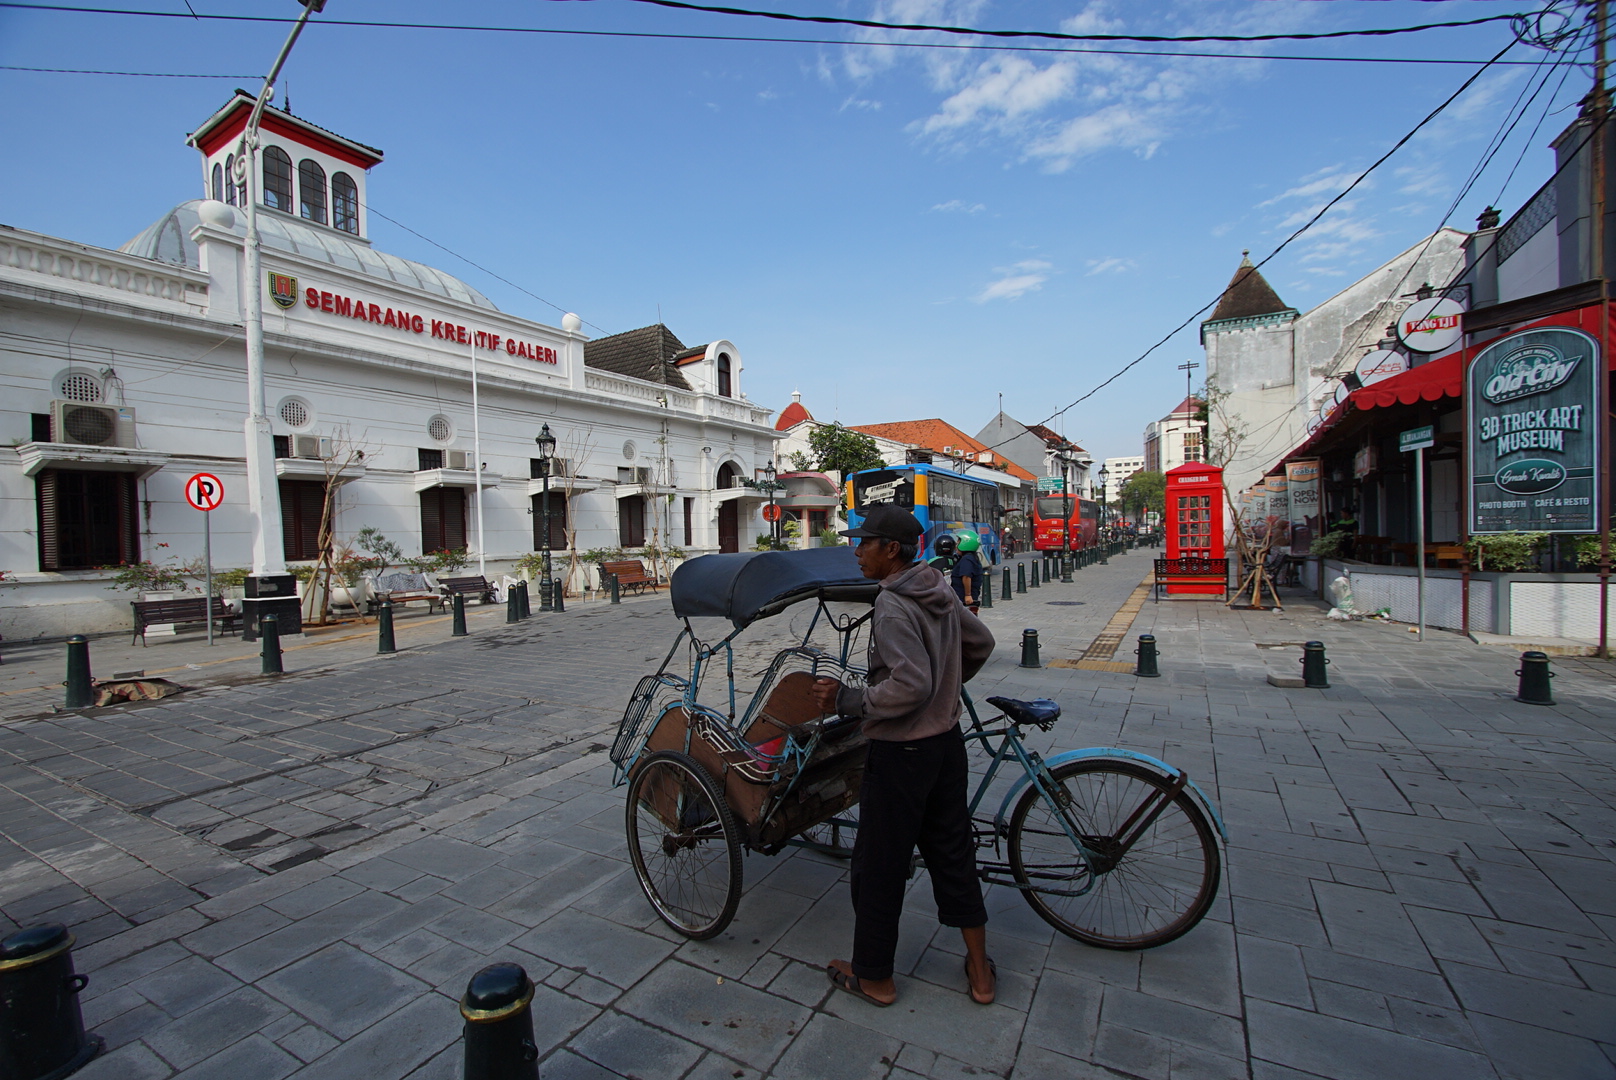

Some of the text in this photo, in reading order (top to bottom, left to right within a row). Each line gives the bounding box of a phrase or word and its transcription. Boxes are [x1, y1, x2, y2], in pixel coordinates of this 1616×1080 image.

[305, 287, 557, 364] SEMARANG KREATIF GALERI
[1438, 316, 1455, 328] TJI
[1487, 361, 1575, 397] Old City
[1481, 405, 1582, 440] 3D TRICK ART
[1497, 429, 1564, 457] MUSEUM
[1293, 490, 1318, 498] OPEN
[1479, 501, 1502, 510] PHOTO
[1503, 500, 1526, 508] BOOTH
[1535, 498, 1554, 507] CAFÉ
[1564, 498, 1589, 506] RESTO
